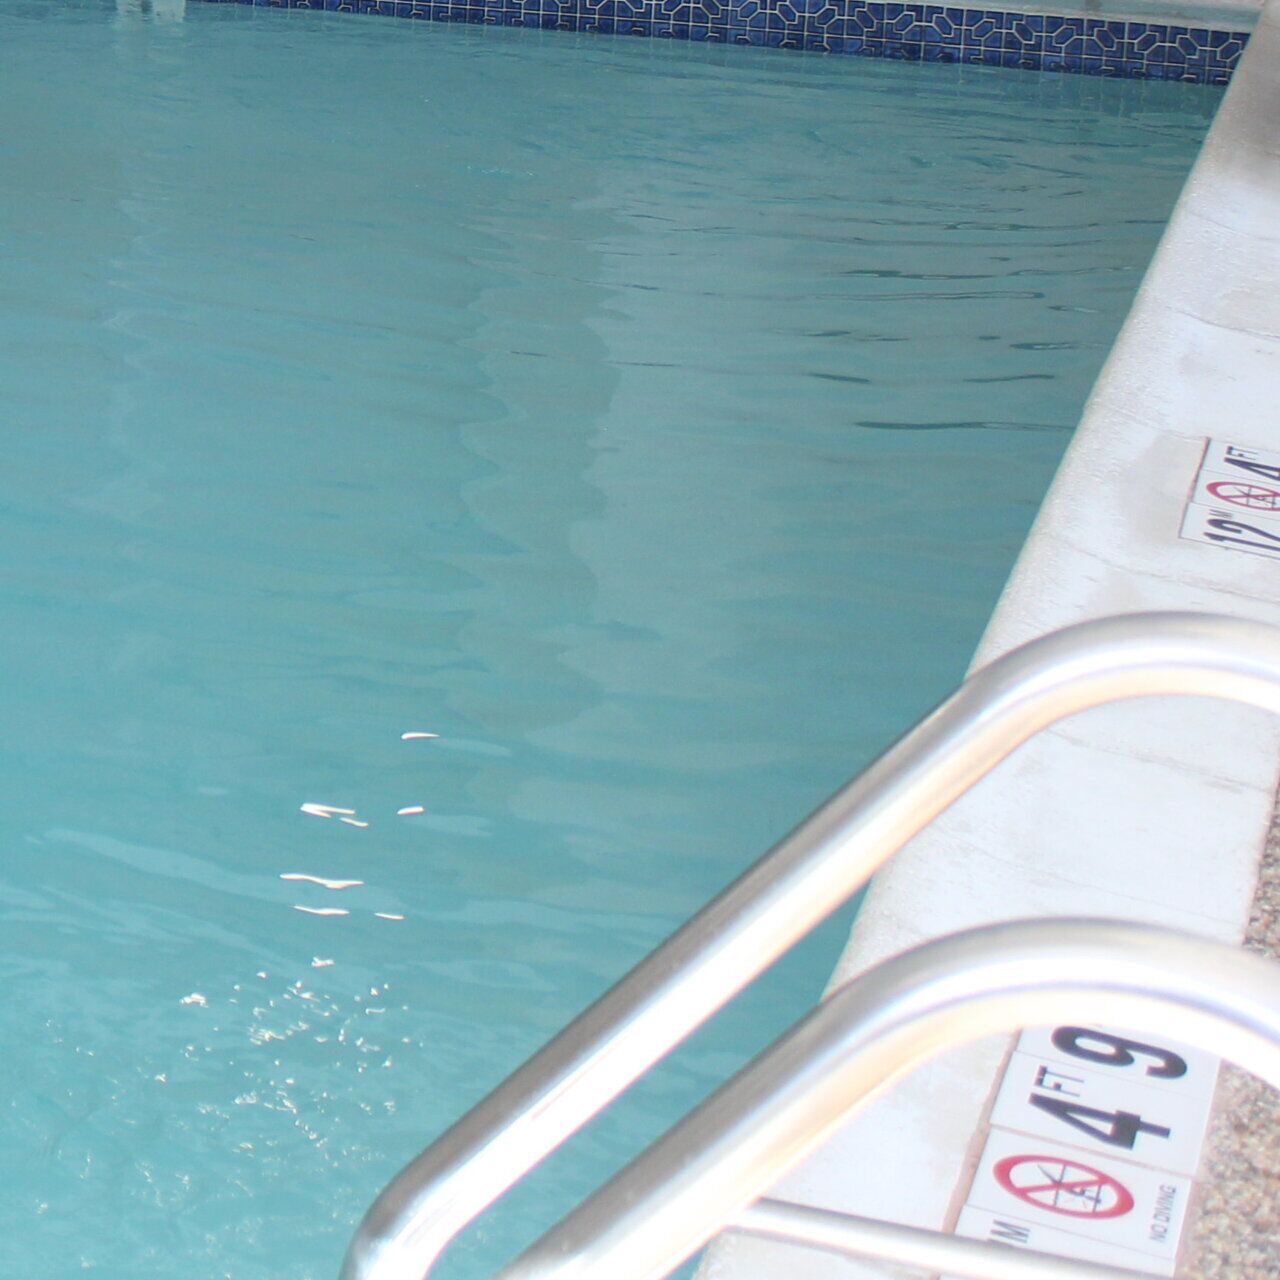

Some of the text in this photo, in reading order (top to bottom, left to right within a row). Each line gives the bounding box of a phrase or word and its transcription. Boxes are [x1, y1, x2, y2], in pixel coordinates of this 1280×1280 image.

[1226, 446, 1258, 460] FT
[1028, 1025, 1188, 1150] 4 FT 9
[990, 1218, 1031, 1244] M
[1149, 1184, 1177, 1243] NO DIVING
